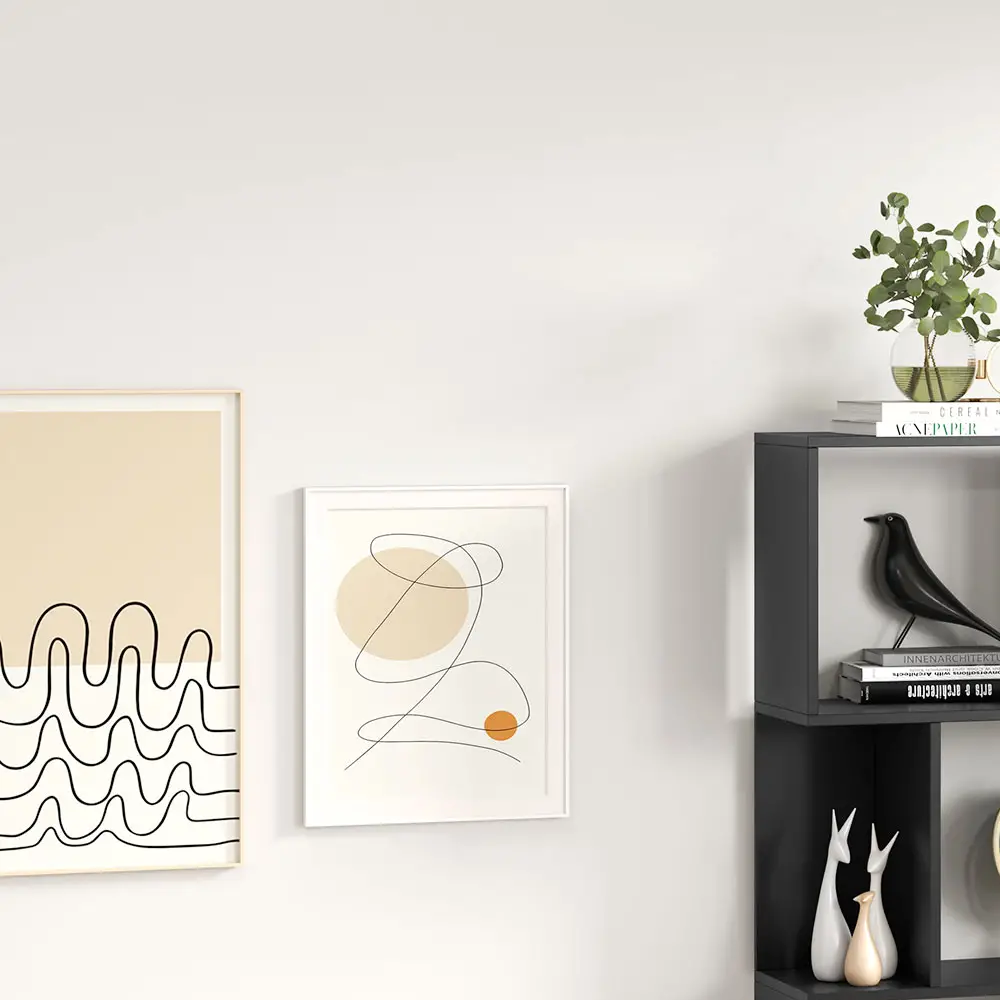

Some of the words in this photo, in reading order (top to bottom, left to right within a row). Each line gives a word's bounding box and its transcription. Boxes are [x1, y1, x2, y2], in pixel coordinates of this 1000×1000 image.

[939, 406, 990, 418] CEREAL
[892, 671, 932, 679] Architects
[907, 684, 961, 699] architecture
[974, 683, 993, 698] arts
